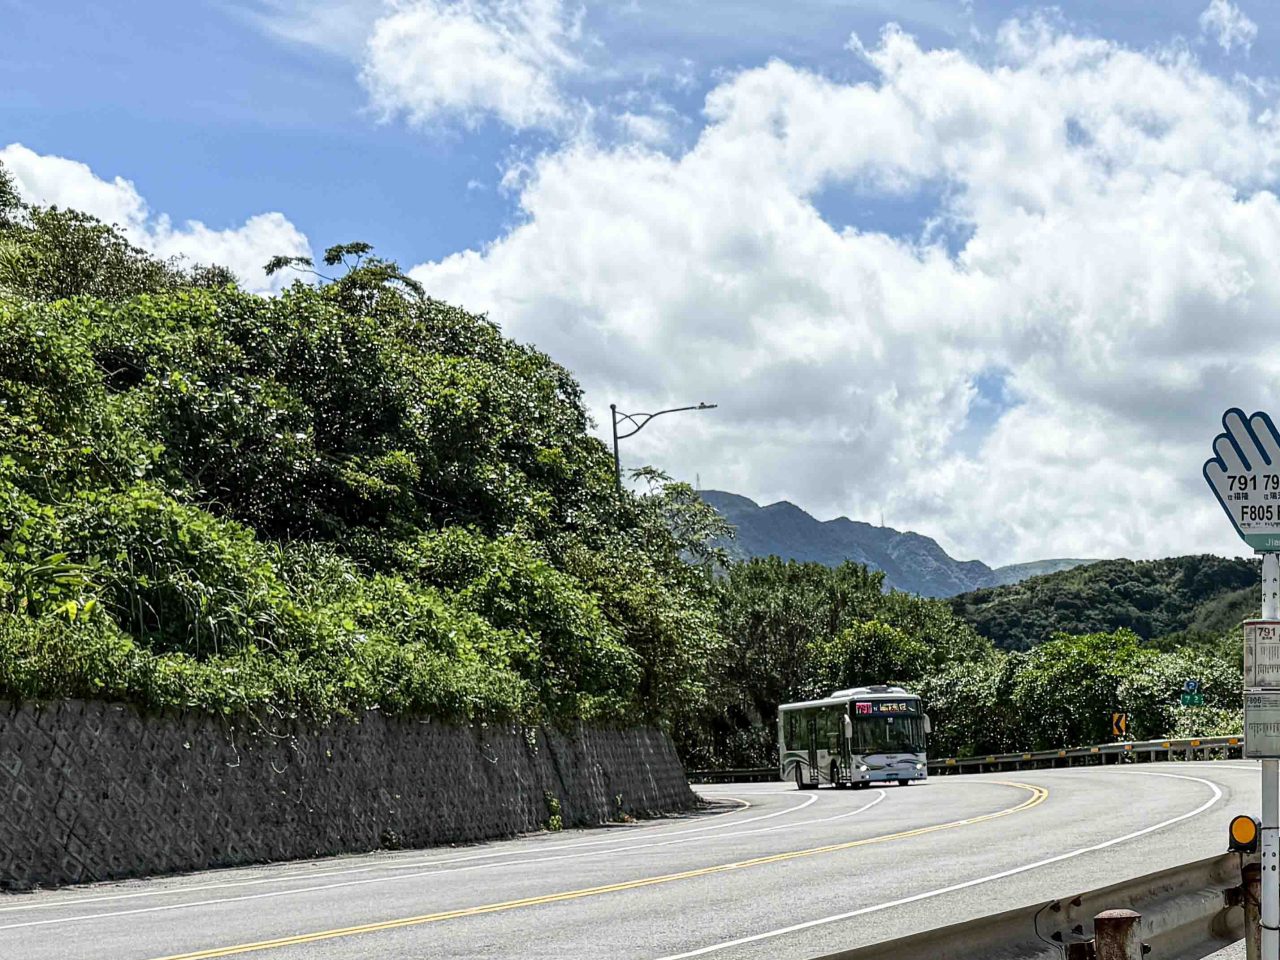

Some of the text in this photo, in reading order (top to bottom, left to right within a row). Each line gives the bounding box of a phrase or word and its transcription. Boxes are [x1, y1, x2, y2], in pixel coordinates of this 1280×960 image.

[1227, 475, 1257, 491] 791
[1241, 505, 1273, 521] F805
[1257, 627, 1276, 637] 791
